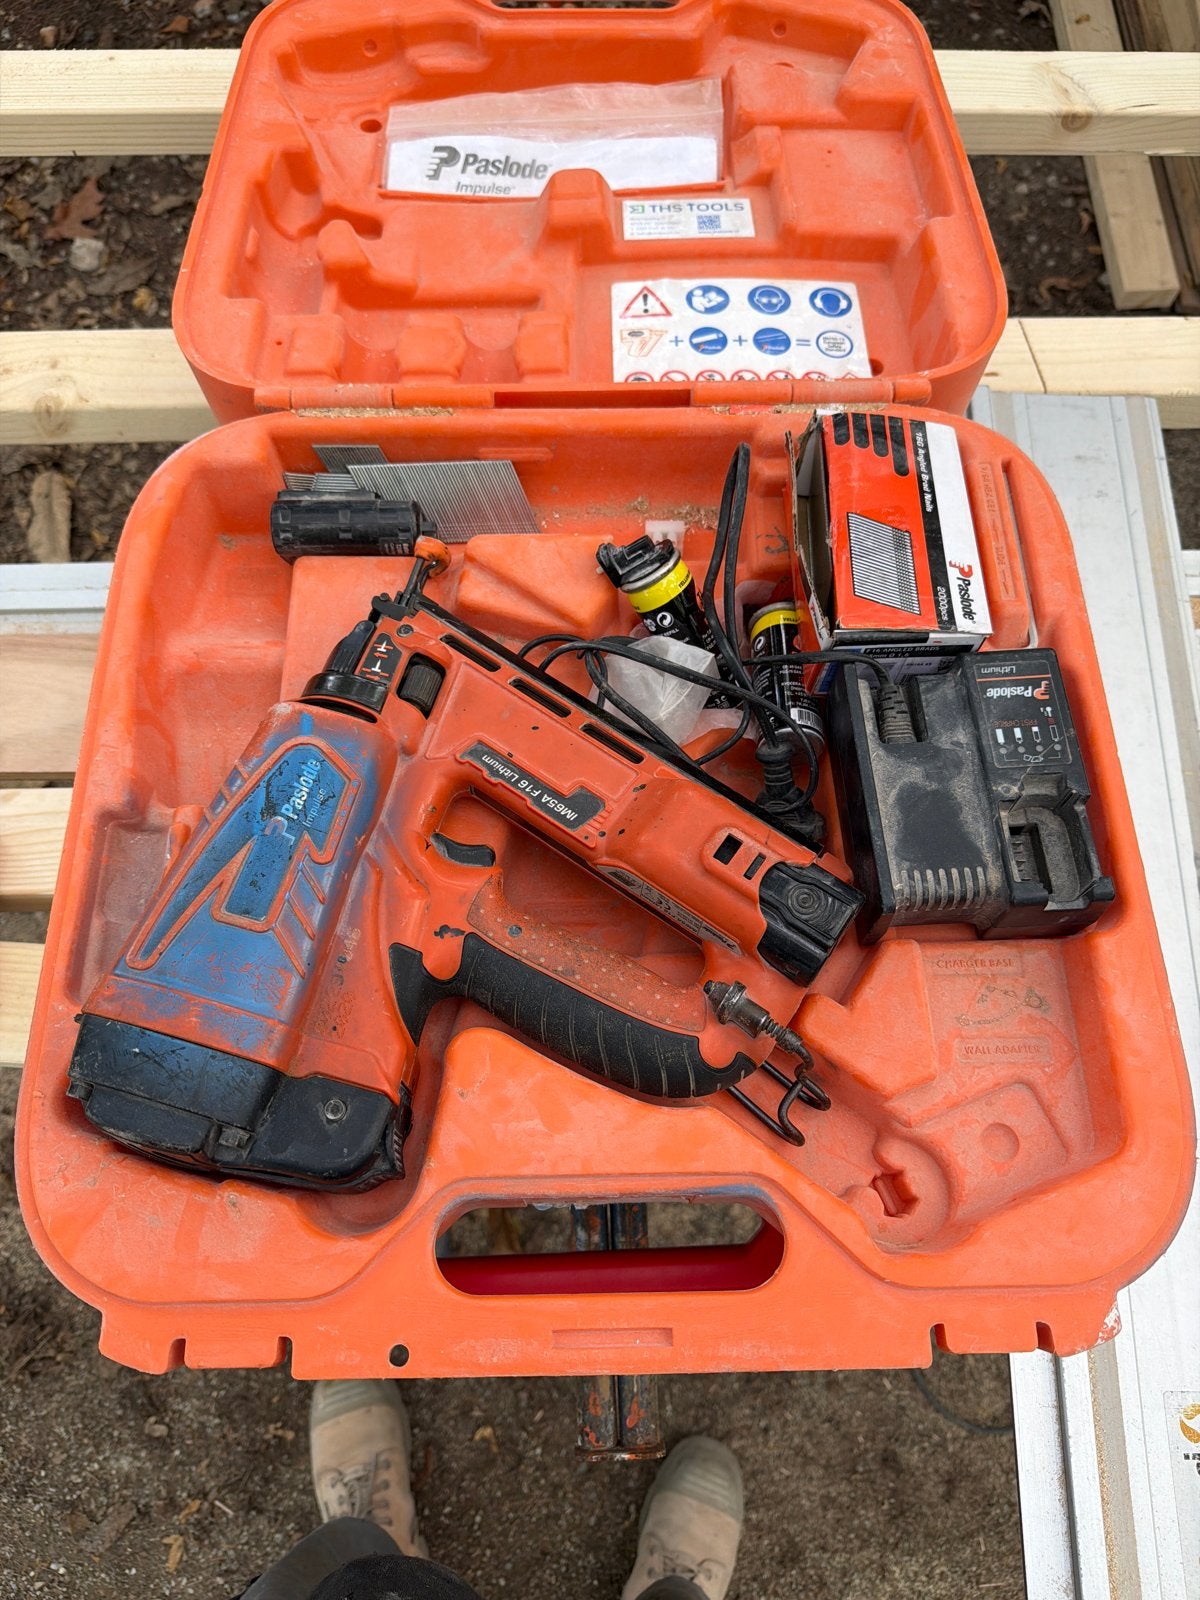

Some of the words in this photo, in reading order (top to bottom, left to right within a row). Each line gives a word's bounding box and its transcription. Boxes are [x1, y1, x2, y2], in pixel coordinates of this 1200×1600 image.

[461, 153, 548, 180] Paslode
[455, 181, 511, 196] Impulse
[649, 204, 683, 213] THS
[686, 203, 745, 212] TOOLS
[937, 586, 949, 621] 2000pcs
[956, 577, 977, 621] Paslode
[981, 665, 1015, 675] Lithium
[986, 686, 1033, 699] Paslode
[482, 754, 520, 782] Lithium
[281, 758, 320, 820] Paslode
[517, 779, 542, 797] F16
[302, 788, 327, 828] Impulse
[541, 793, 579, 821] IM65A
